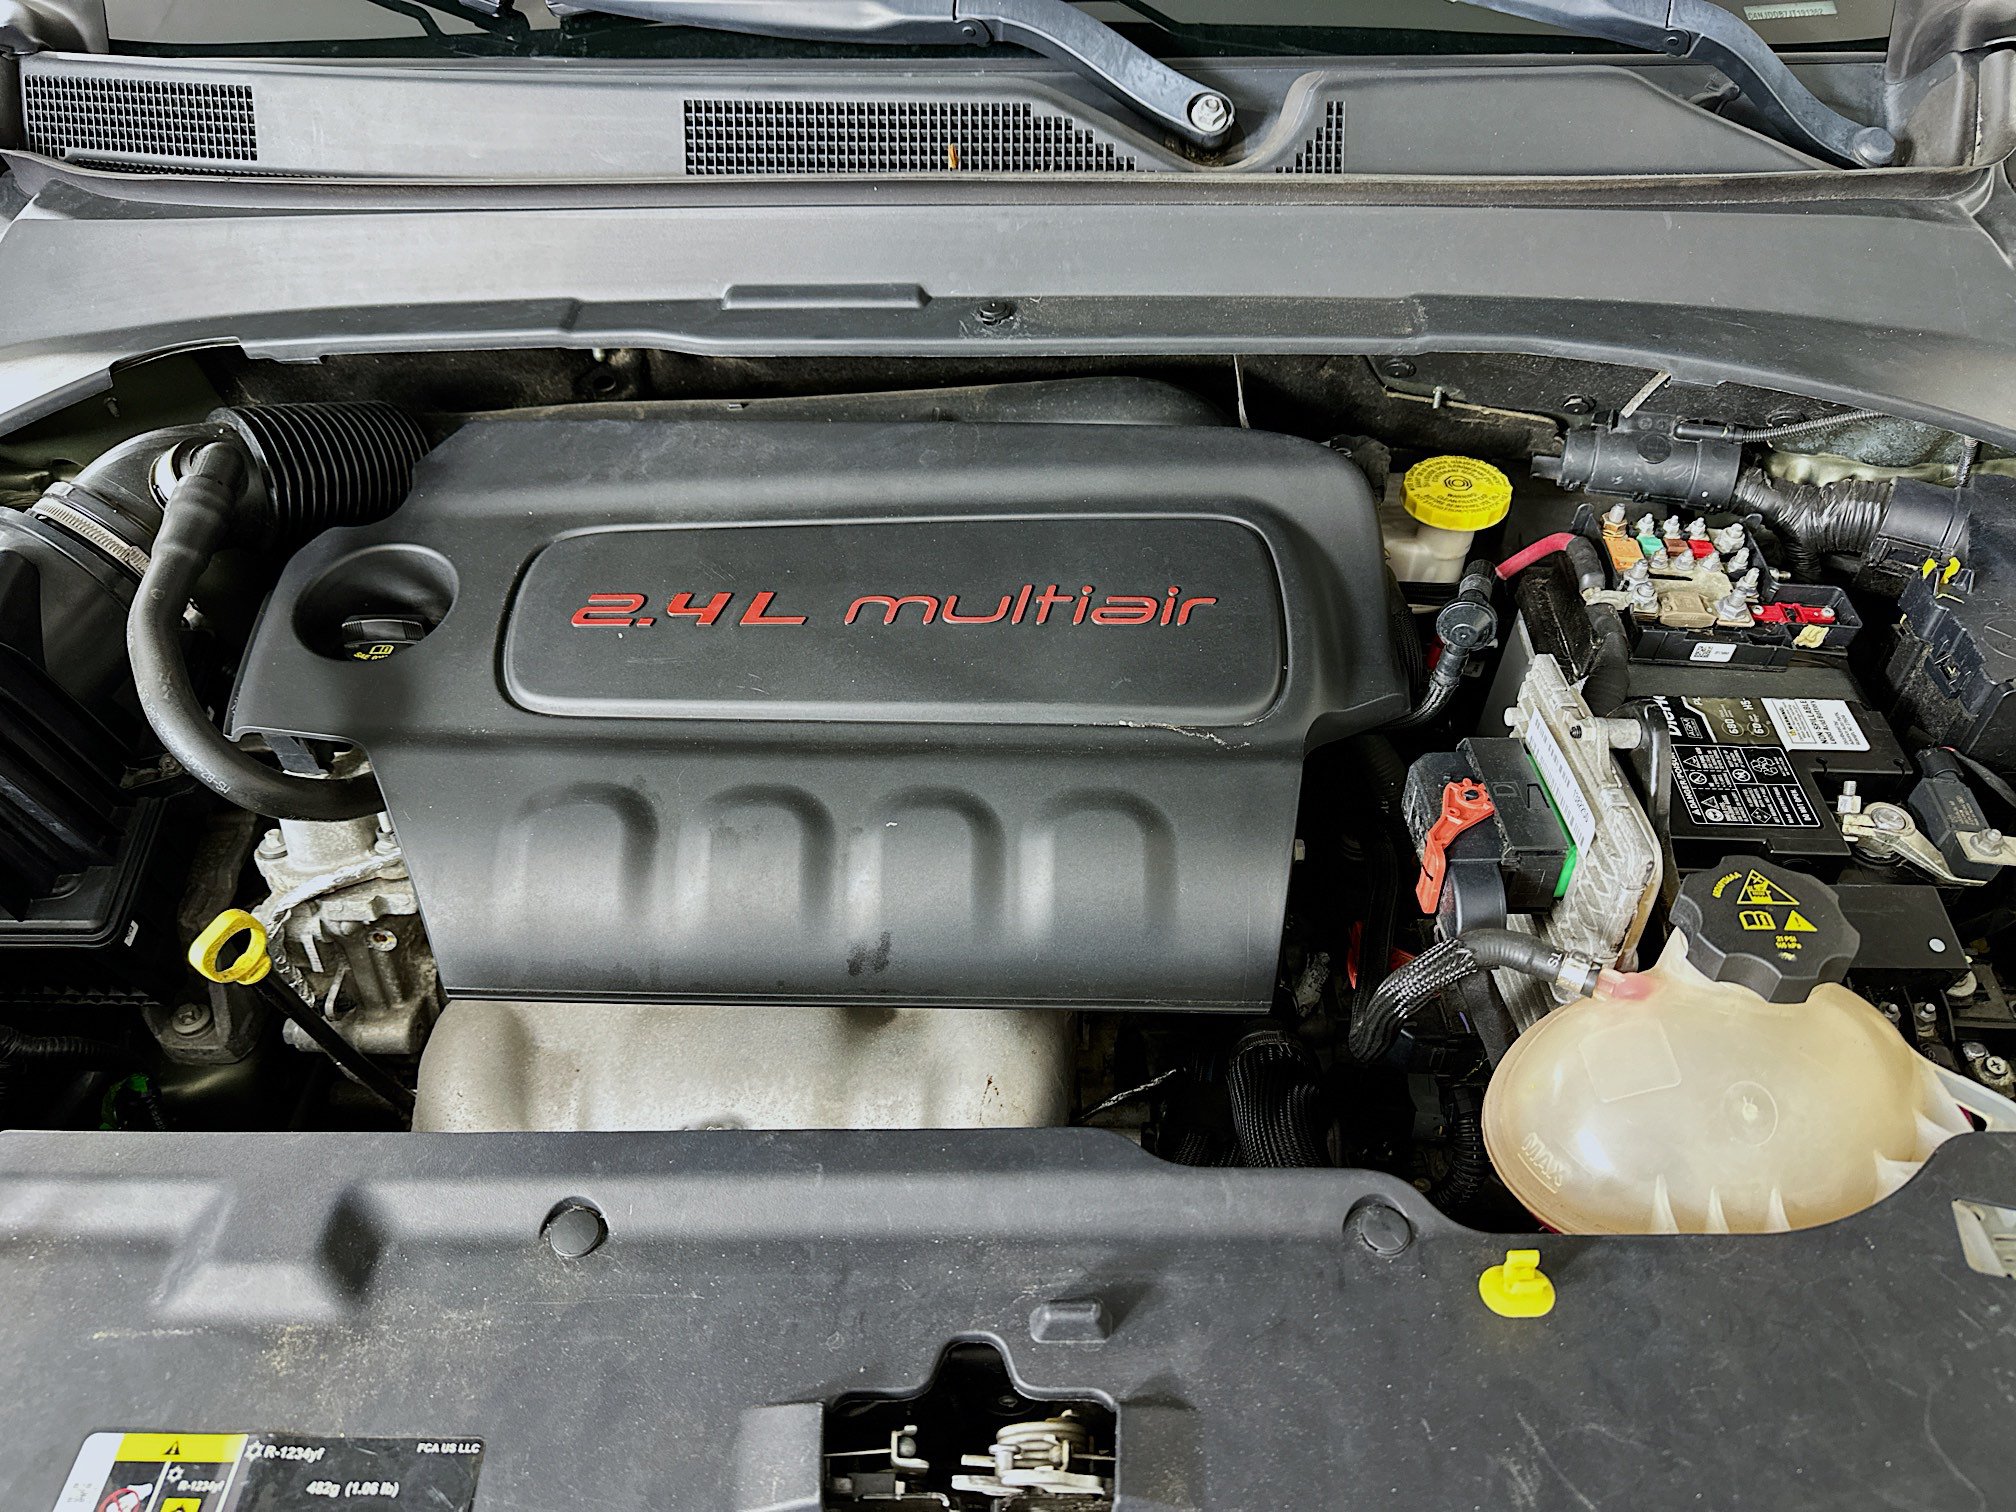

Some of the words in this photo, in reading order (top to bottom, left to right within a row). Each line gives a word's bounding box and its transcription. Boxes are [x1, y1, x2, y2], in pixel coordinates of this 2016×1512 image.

[844, 584, 1218, 627] multiair
[1724, 719, 1738, 734] 680
[1752, 723, 1764, 733] 60
[1521, 1132, 1567, 1187] MAX
[416, 1443, 440, 1454] FCA
[441, 1443, 458, 1454] US
[458, 1443, 482, 1454] LLC
